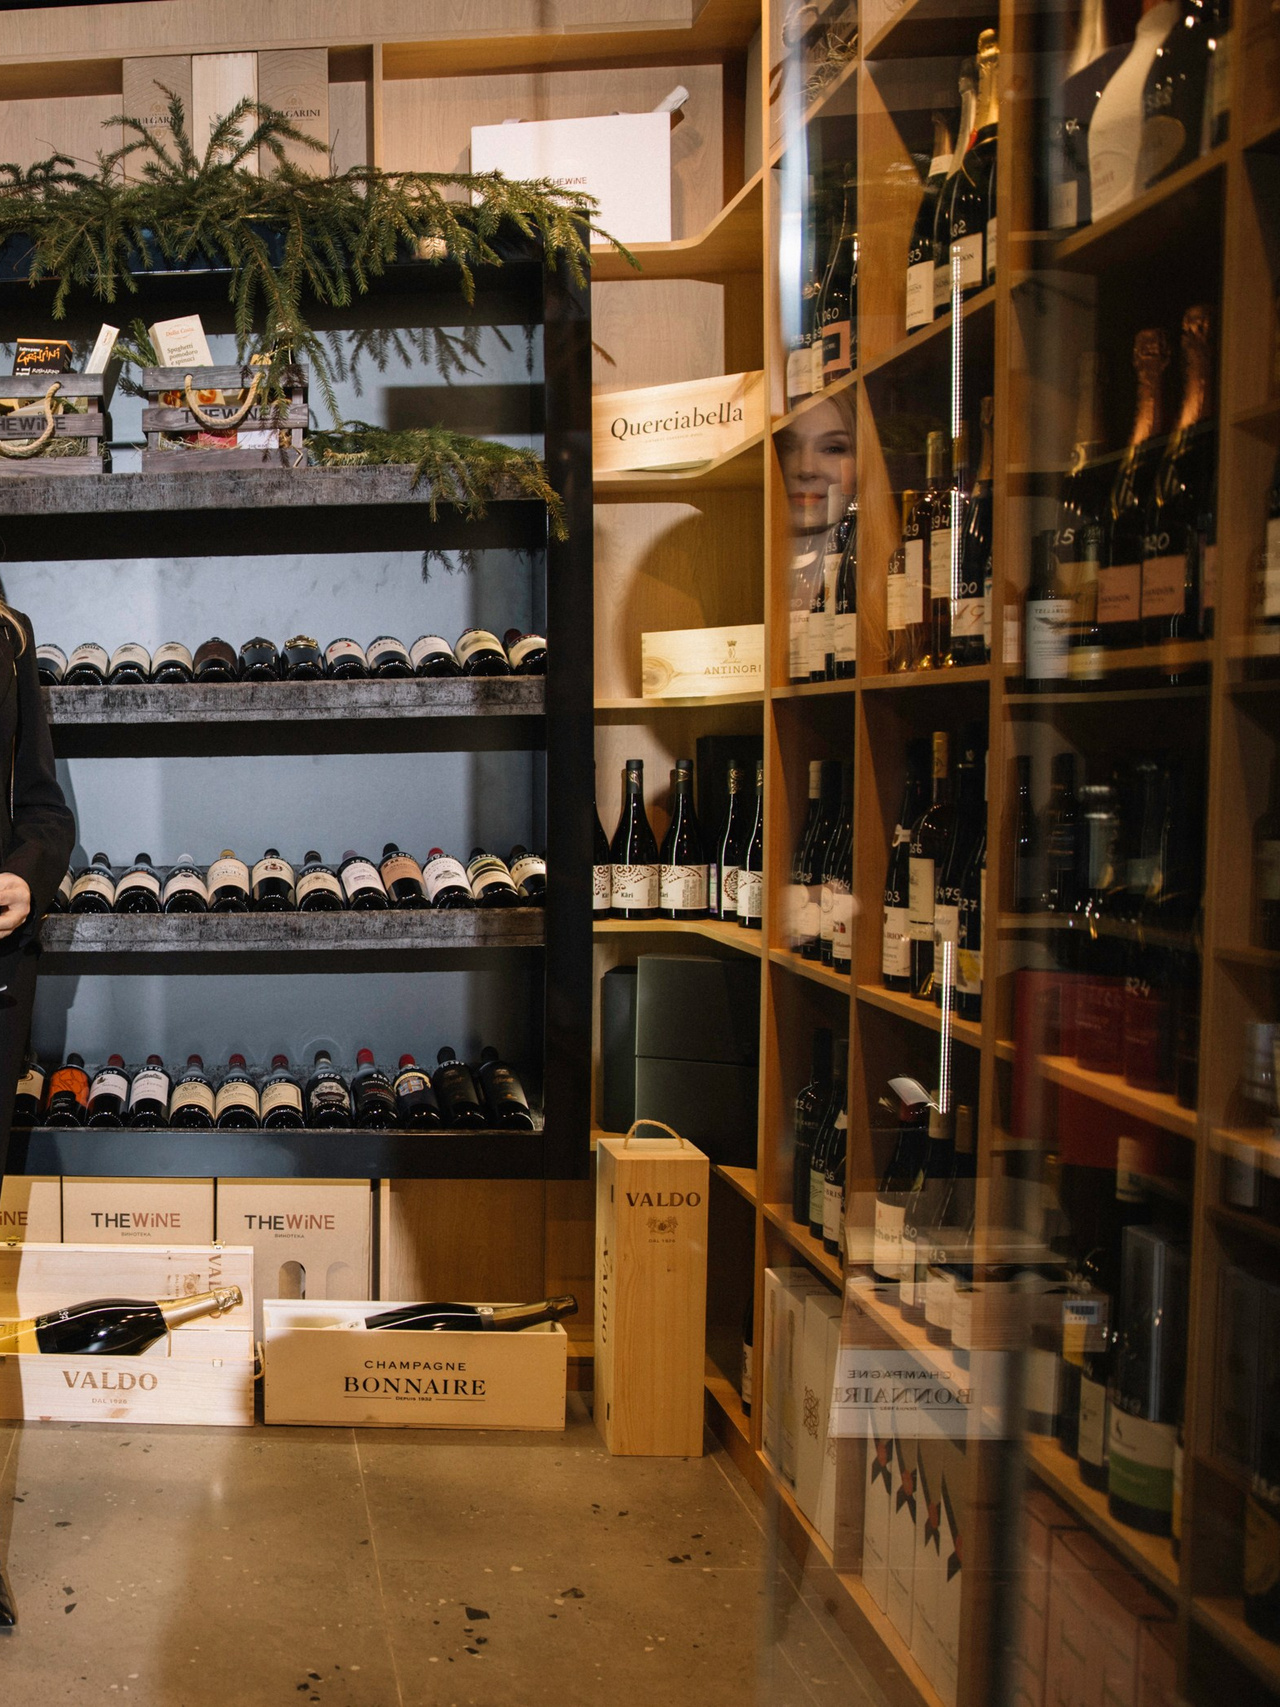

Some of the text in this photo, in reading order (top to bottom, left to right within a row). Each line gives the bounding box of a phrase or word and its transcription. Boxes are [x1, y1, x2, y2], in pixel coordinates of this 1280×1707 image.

[167, 343, 194, 354] Spaghetti
[610, 401, 744, 441] Querciabella
[703, 664, 763, 676] ANTINORI
[626, 1191, 702, 1208] VALDO
[364, 1359, 467, 1372] CHAMPAGNE
[61, 1370, 159, 1391] VALDO
[343, 1375, 487, 1396] BONNAIRE
